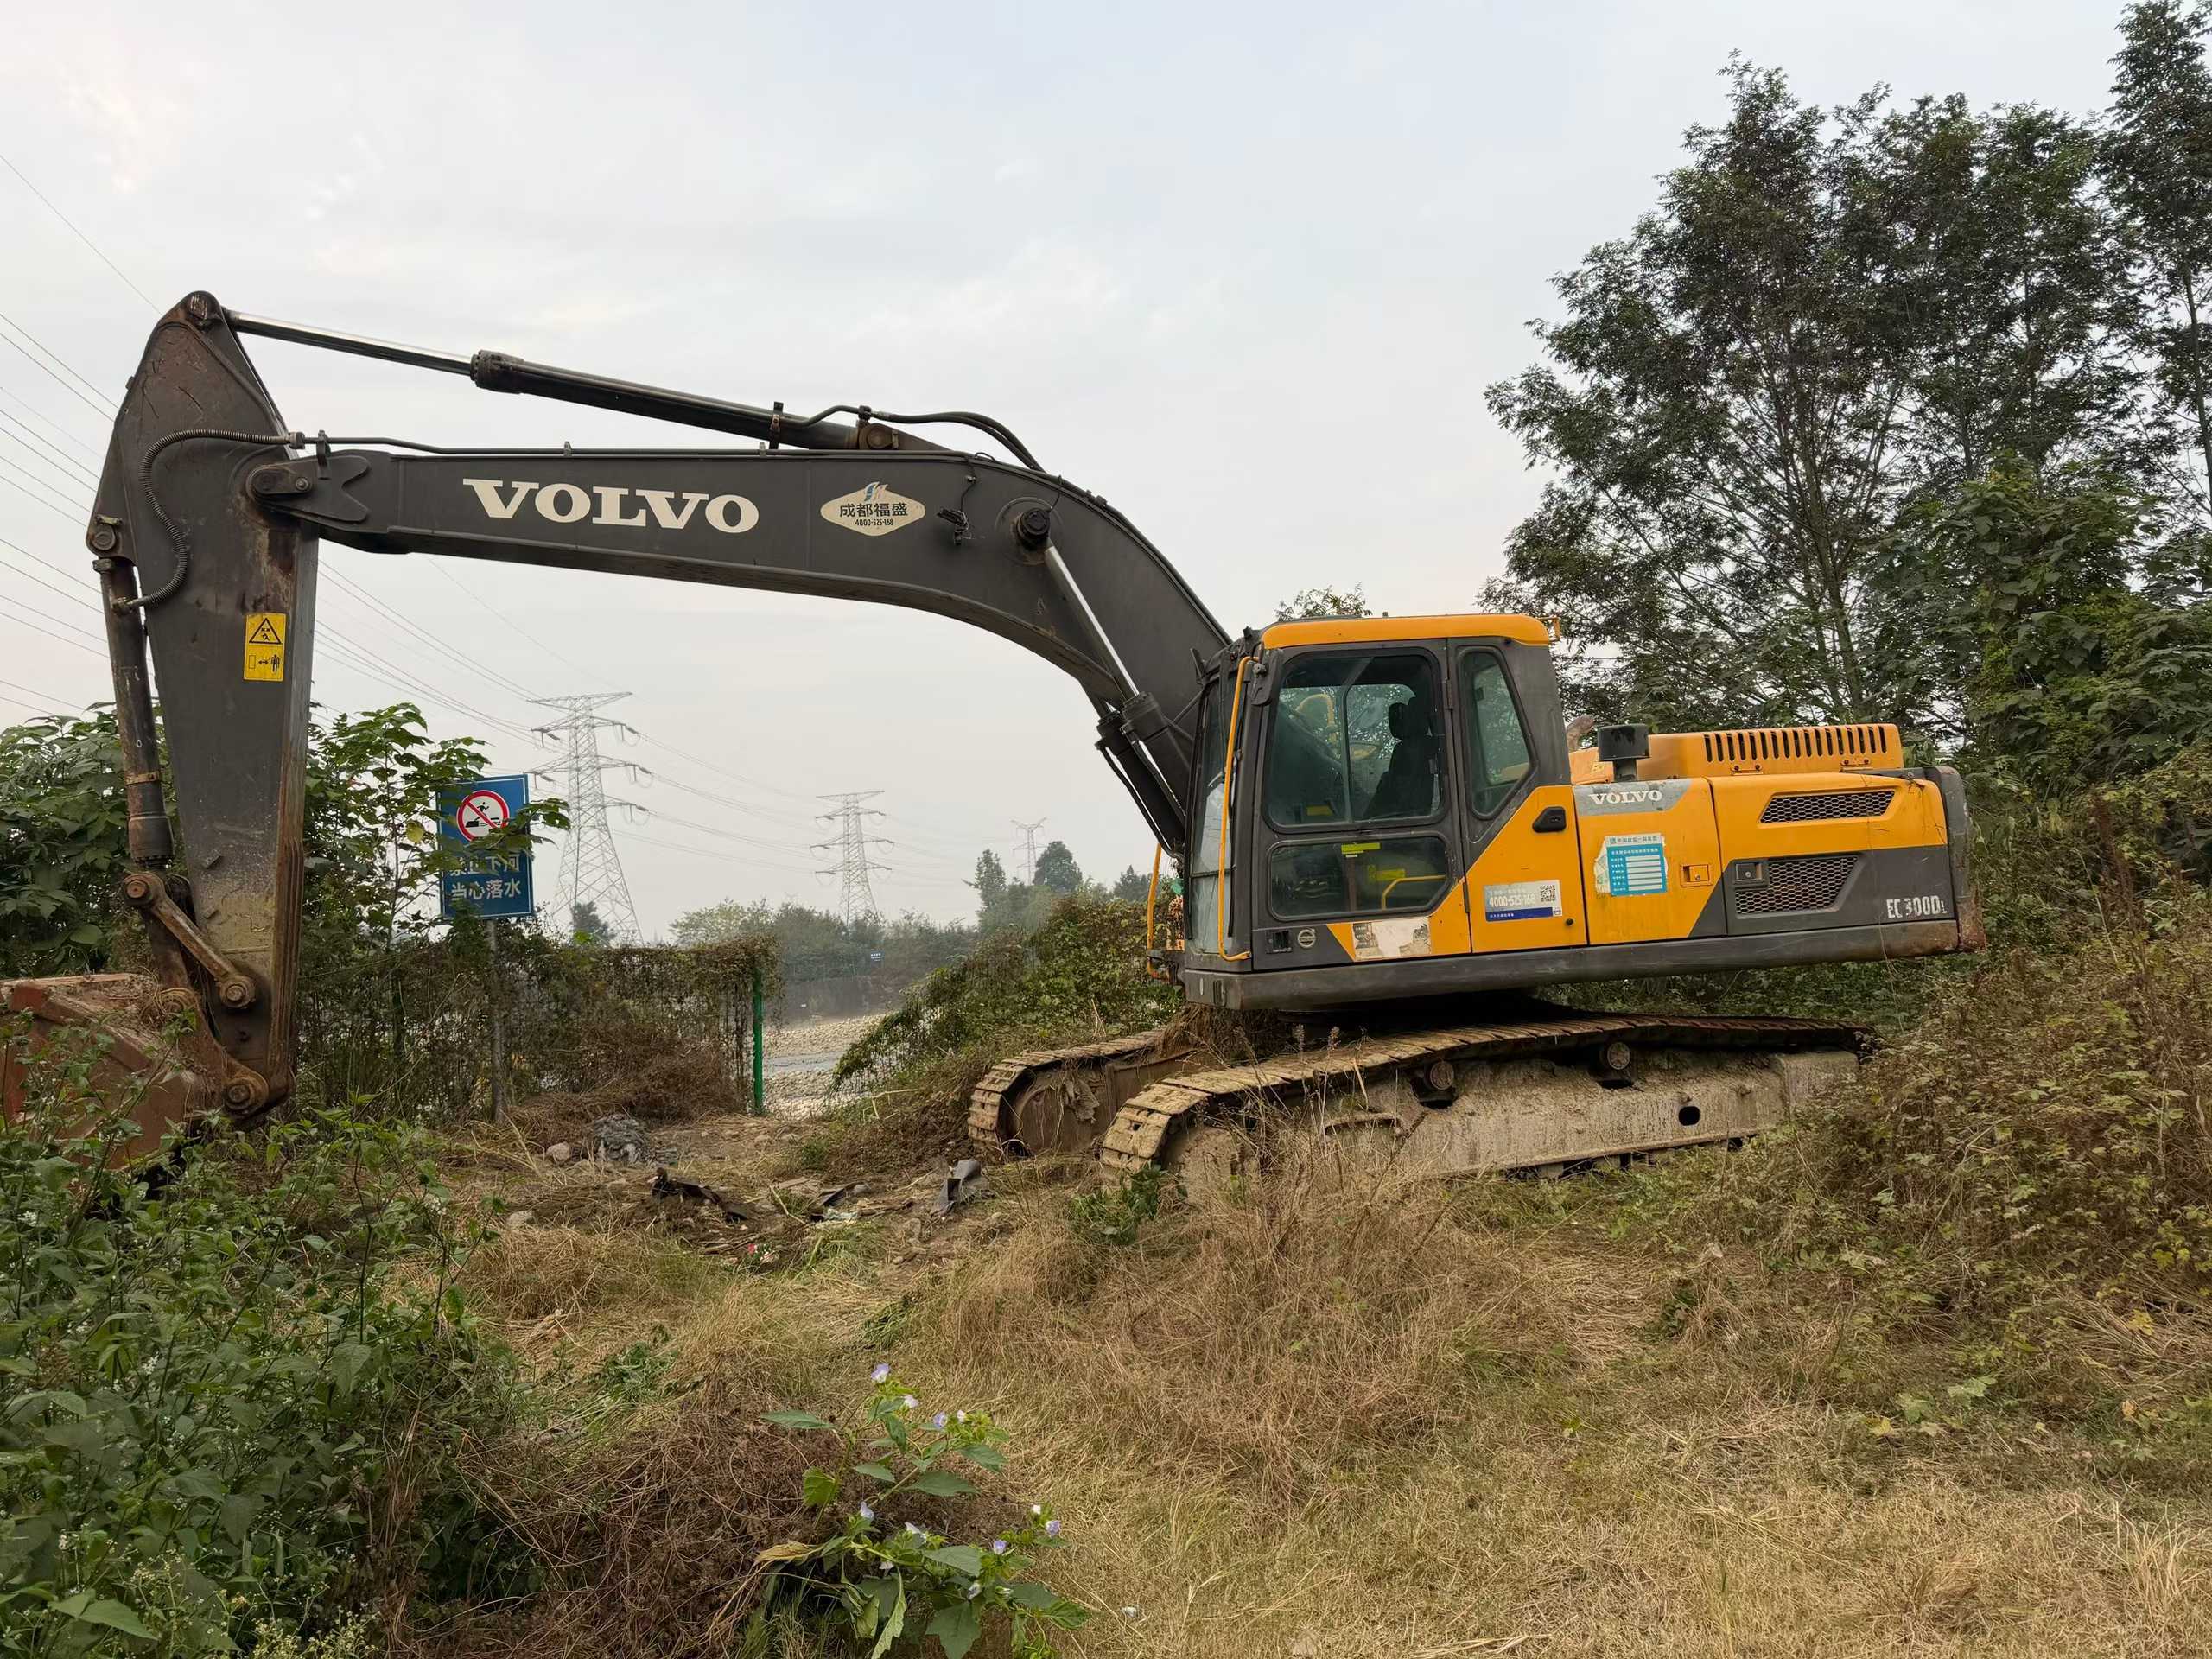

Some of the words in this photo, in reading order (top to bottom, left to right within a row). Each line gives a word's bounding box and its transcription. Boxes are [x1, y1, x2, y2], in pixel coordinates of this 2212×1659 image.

[463, 478, 759, 533] VOLVO
[839, 503, 908, 517] 成都福盛
[1588, 790, 1662, 804] VOLVO
[451, 878, 521, 900] 当心落水
